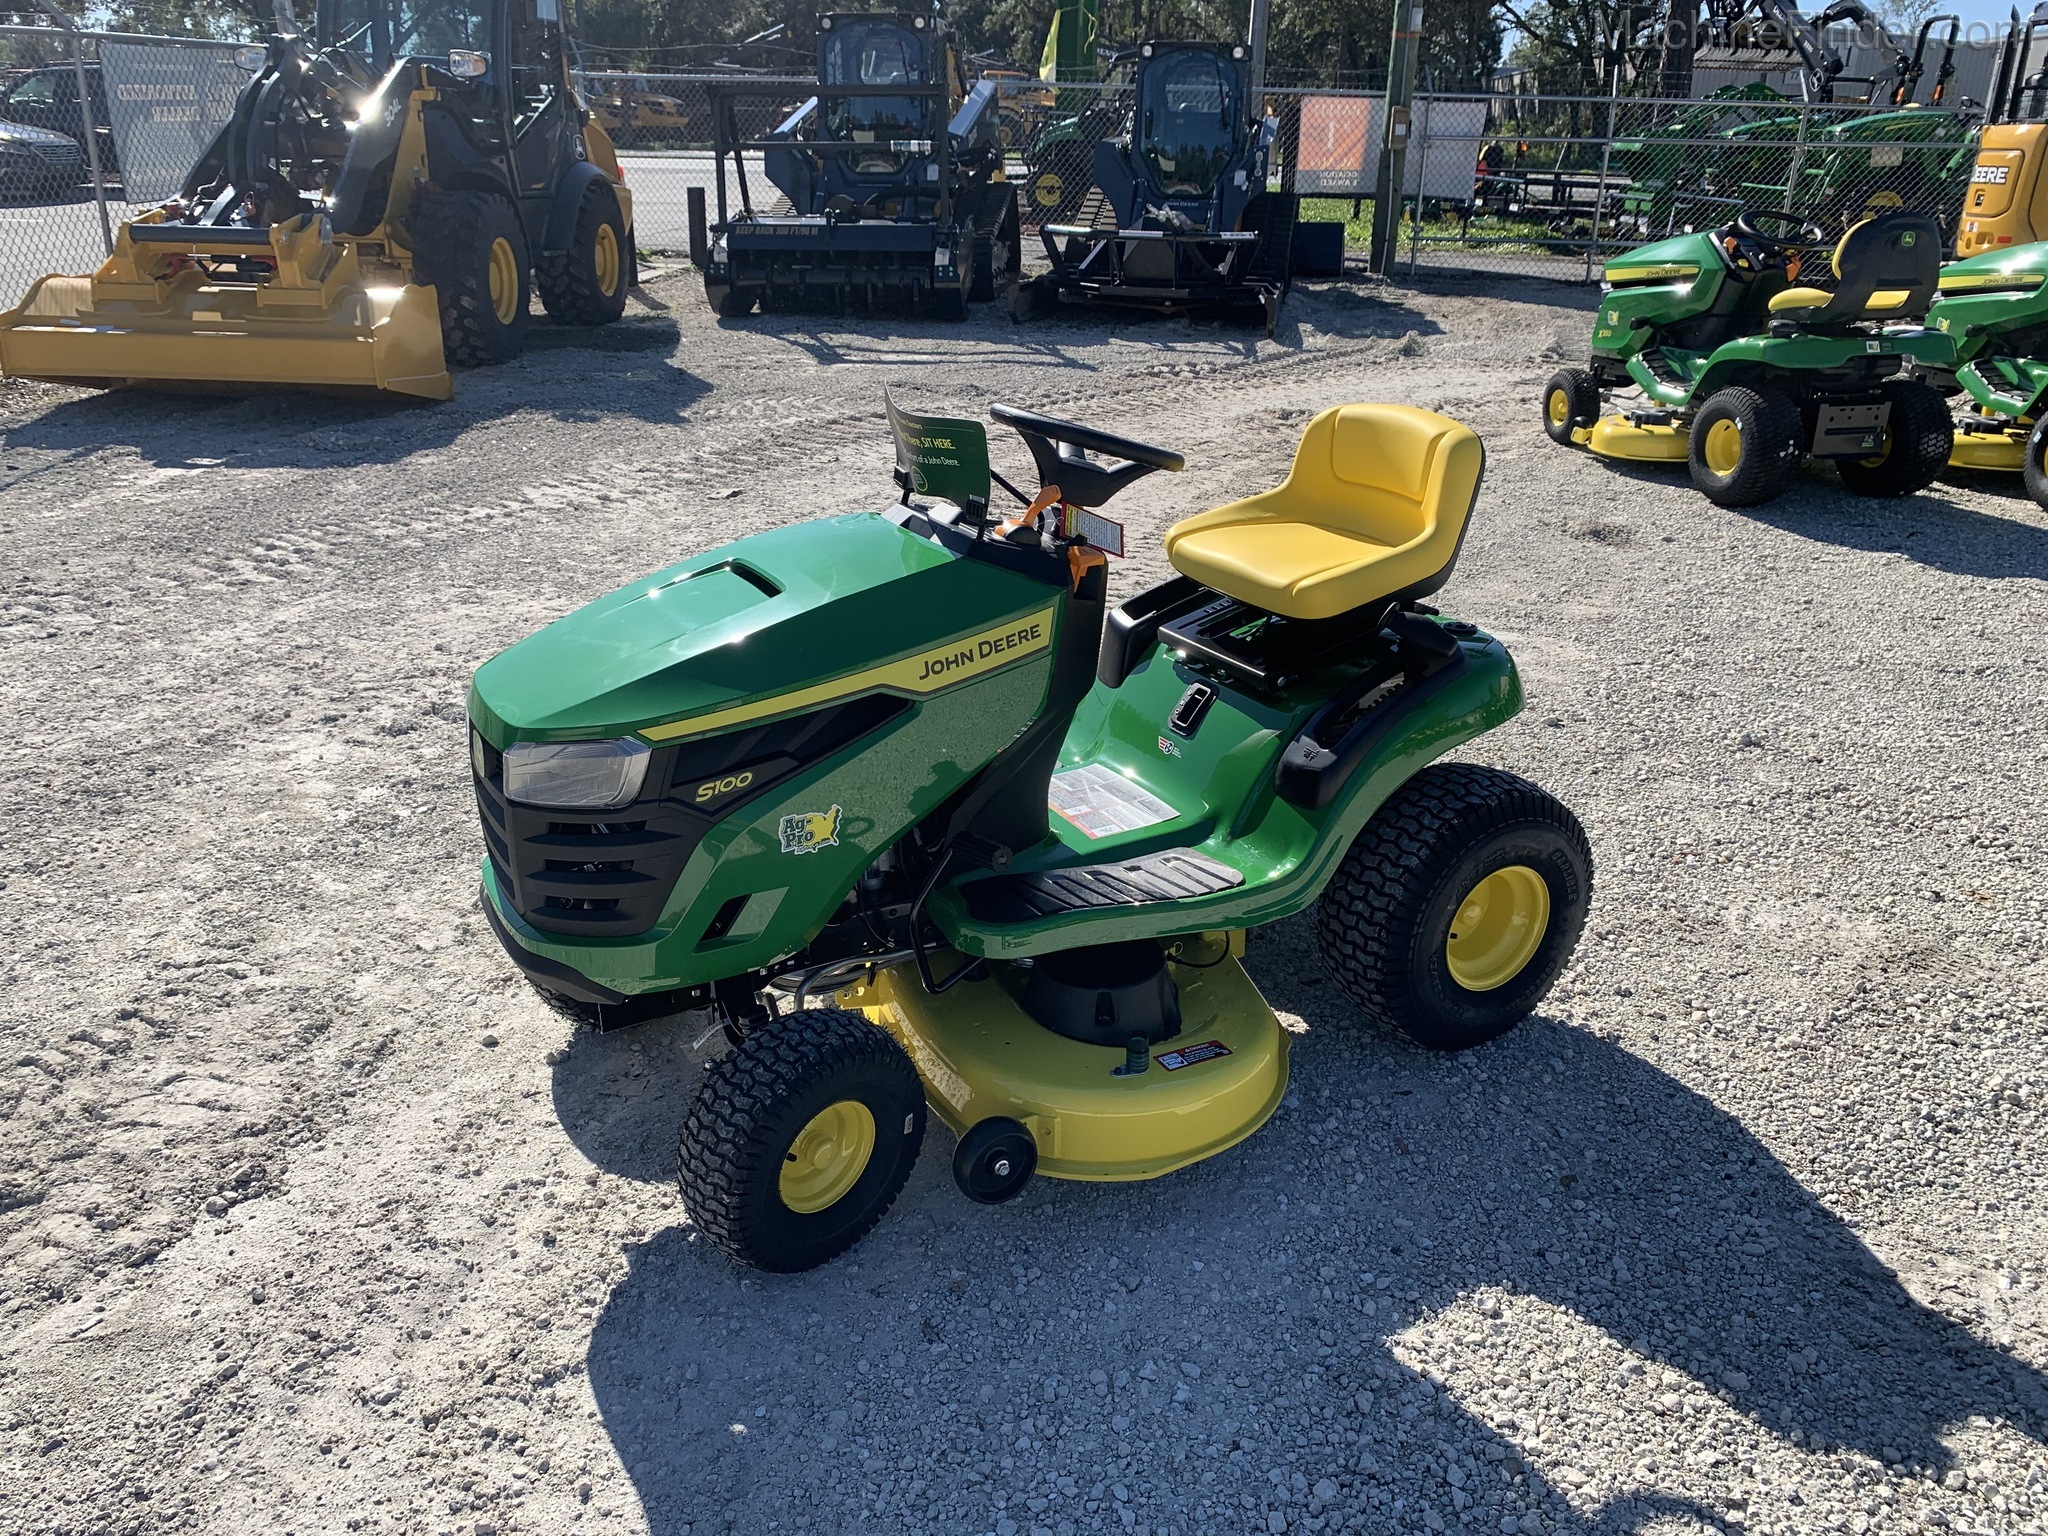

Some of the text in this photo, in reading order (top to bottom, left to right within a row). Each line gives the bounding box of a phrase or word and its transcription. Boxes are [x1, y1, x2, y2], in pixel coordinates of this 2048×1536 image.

[735, 227, 754, 235] KEEP
[755, 226, 773, 235] BACK
[775, 227, 789, 235] 300
[1645, 268, 1682, 278] JOHN DEERE
[1982, 276, 2025, 286] JOHN DEERE
[921, 437, 933, 448] SIT
[932, 438, 957, 450] HERE.
[927, 456, 942, 465] John
[940, 456, 960, 467] Deere.
[919, 623, 1042, 681] JOHN DEERE
[695, 772, 753, 802] S100
[784, 830, 815, 849] Pro
